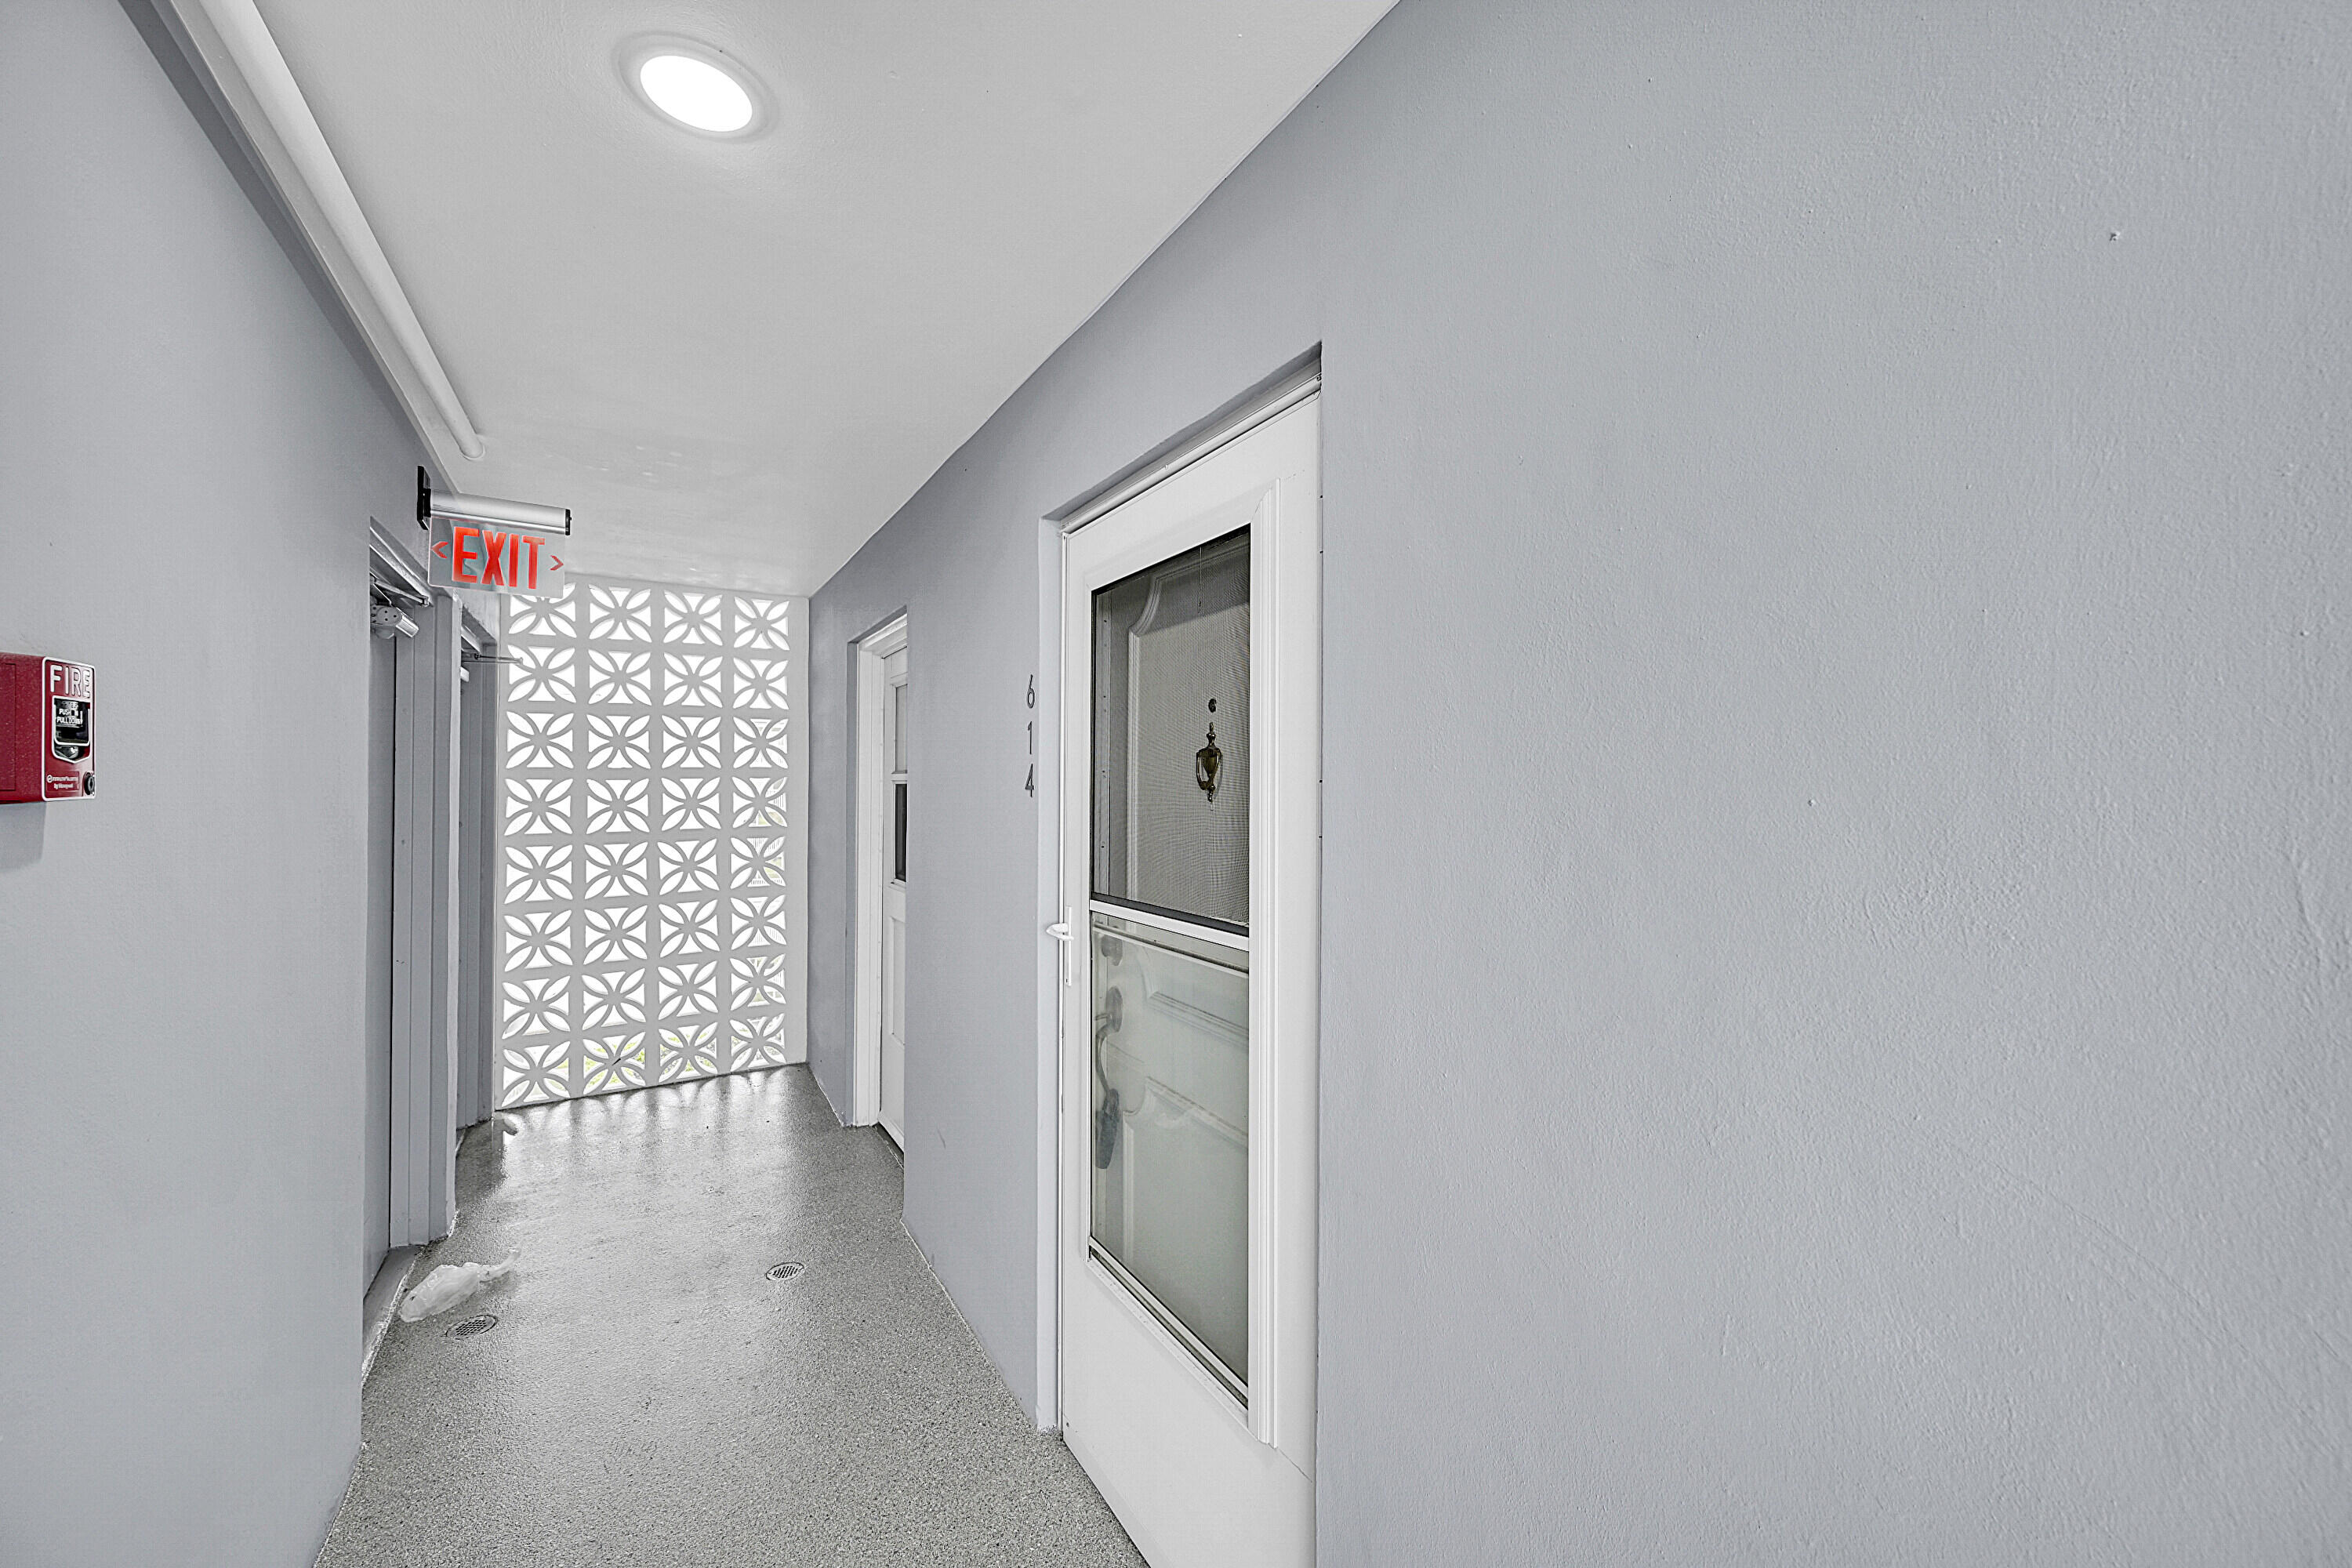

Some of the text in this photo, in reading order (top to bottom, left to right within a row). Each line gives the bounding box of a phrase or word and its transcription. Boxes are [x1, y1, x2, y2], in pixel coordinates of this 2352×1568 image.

[452, 526, 546, 590] EXIT
[49, 664, 91, 699] FIRE
[1025, 674, 1035, 798] 614
